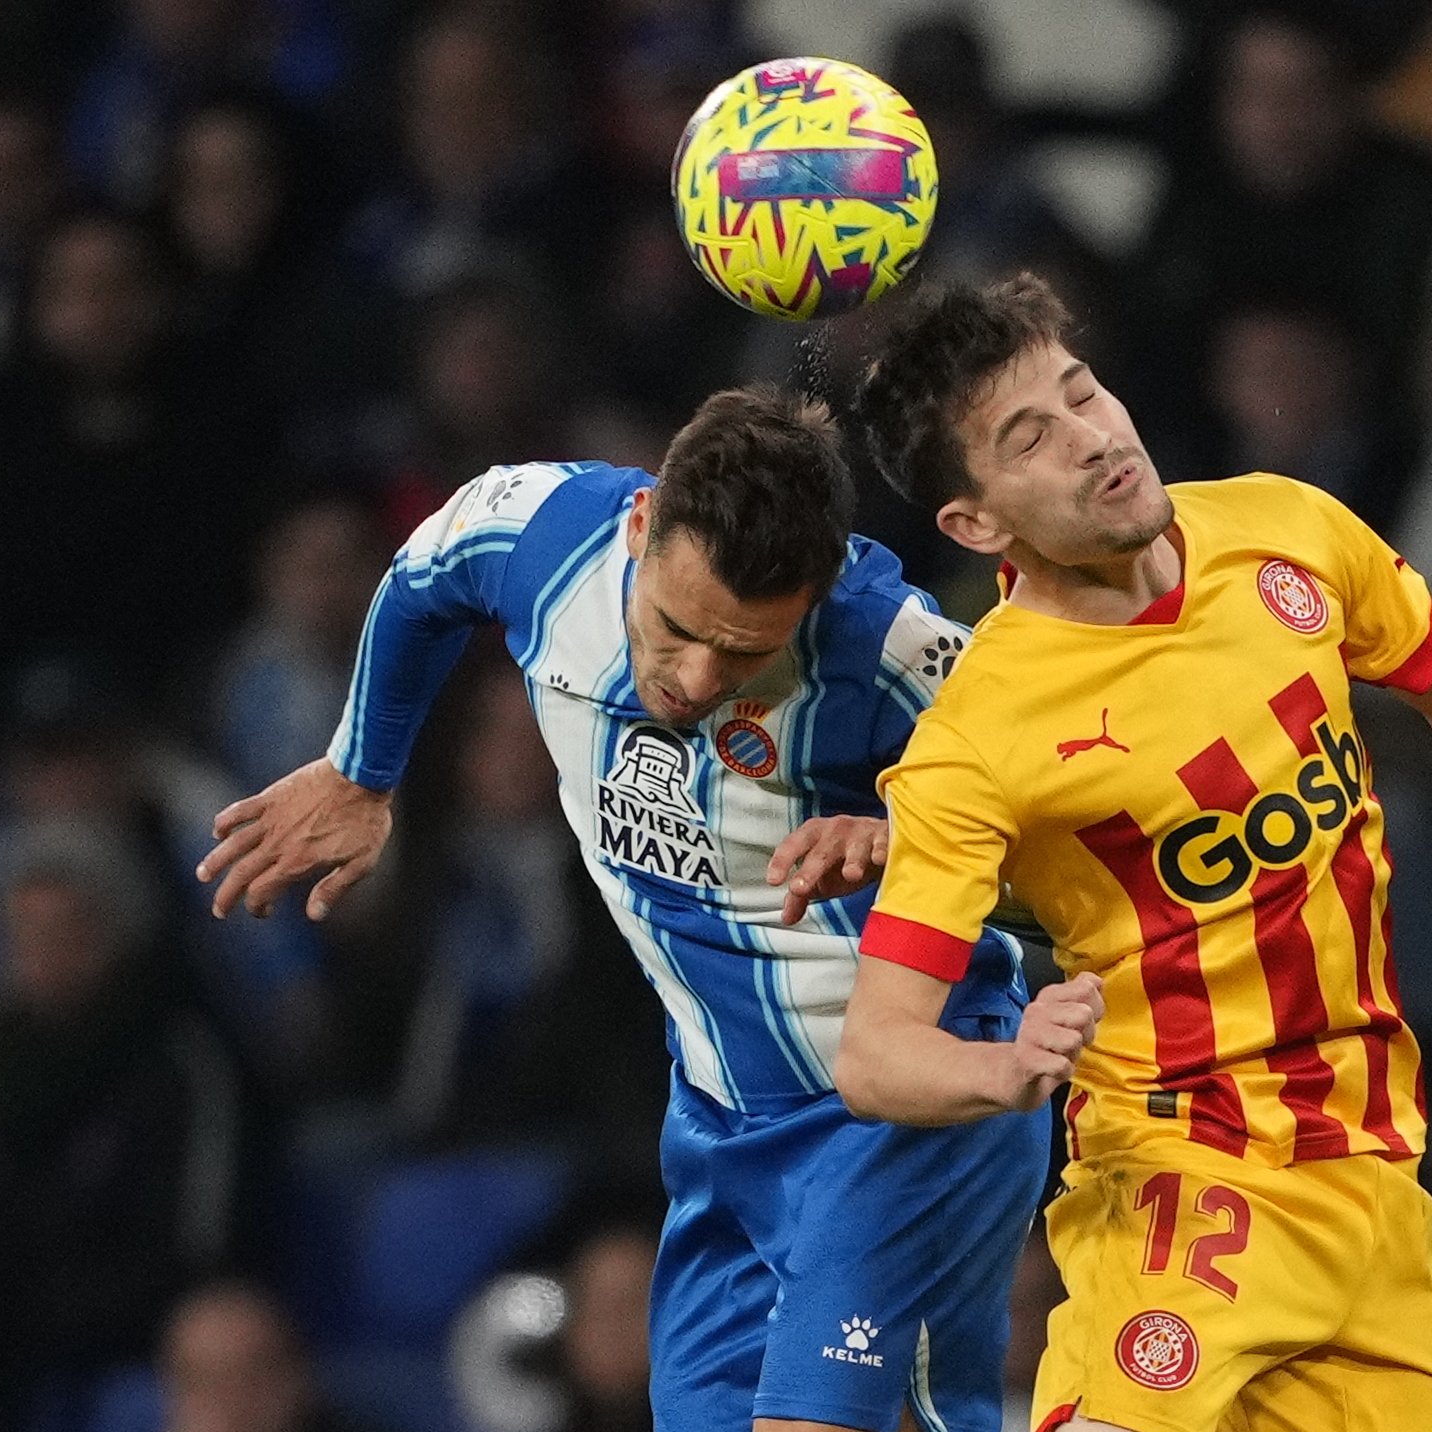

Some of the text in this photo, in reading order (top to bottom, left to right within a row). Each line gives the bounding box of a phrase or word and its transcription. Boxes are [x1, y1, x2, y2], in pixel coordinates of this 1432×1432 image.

[1262, 565, 1295, 591] GIRONA
[598, 783, 715, 851] RIVIERA
[599, 814, 724, 887] MAYA
[1134, 1171, 1251, 1304] 12
[1139, 1316, 1189, 1343] GIRONA
[822, 1345, 884, 1368] KELME
